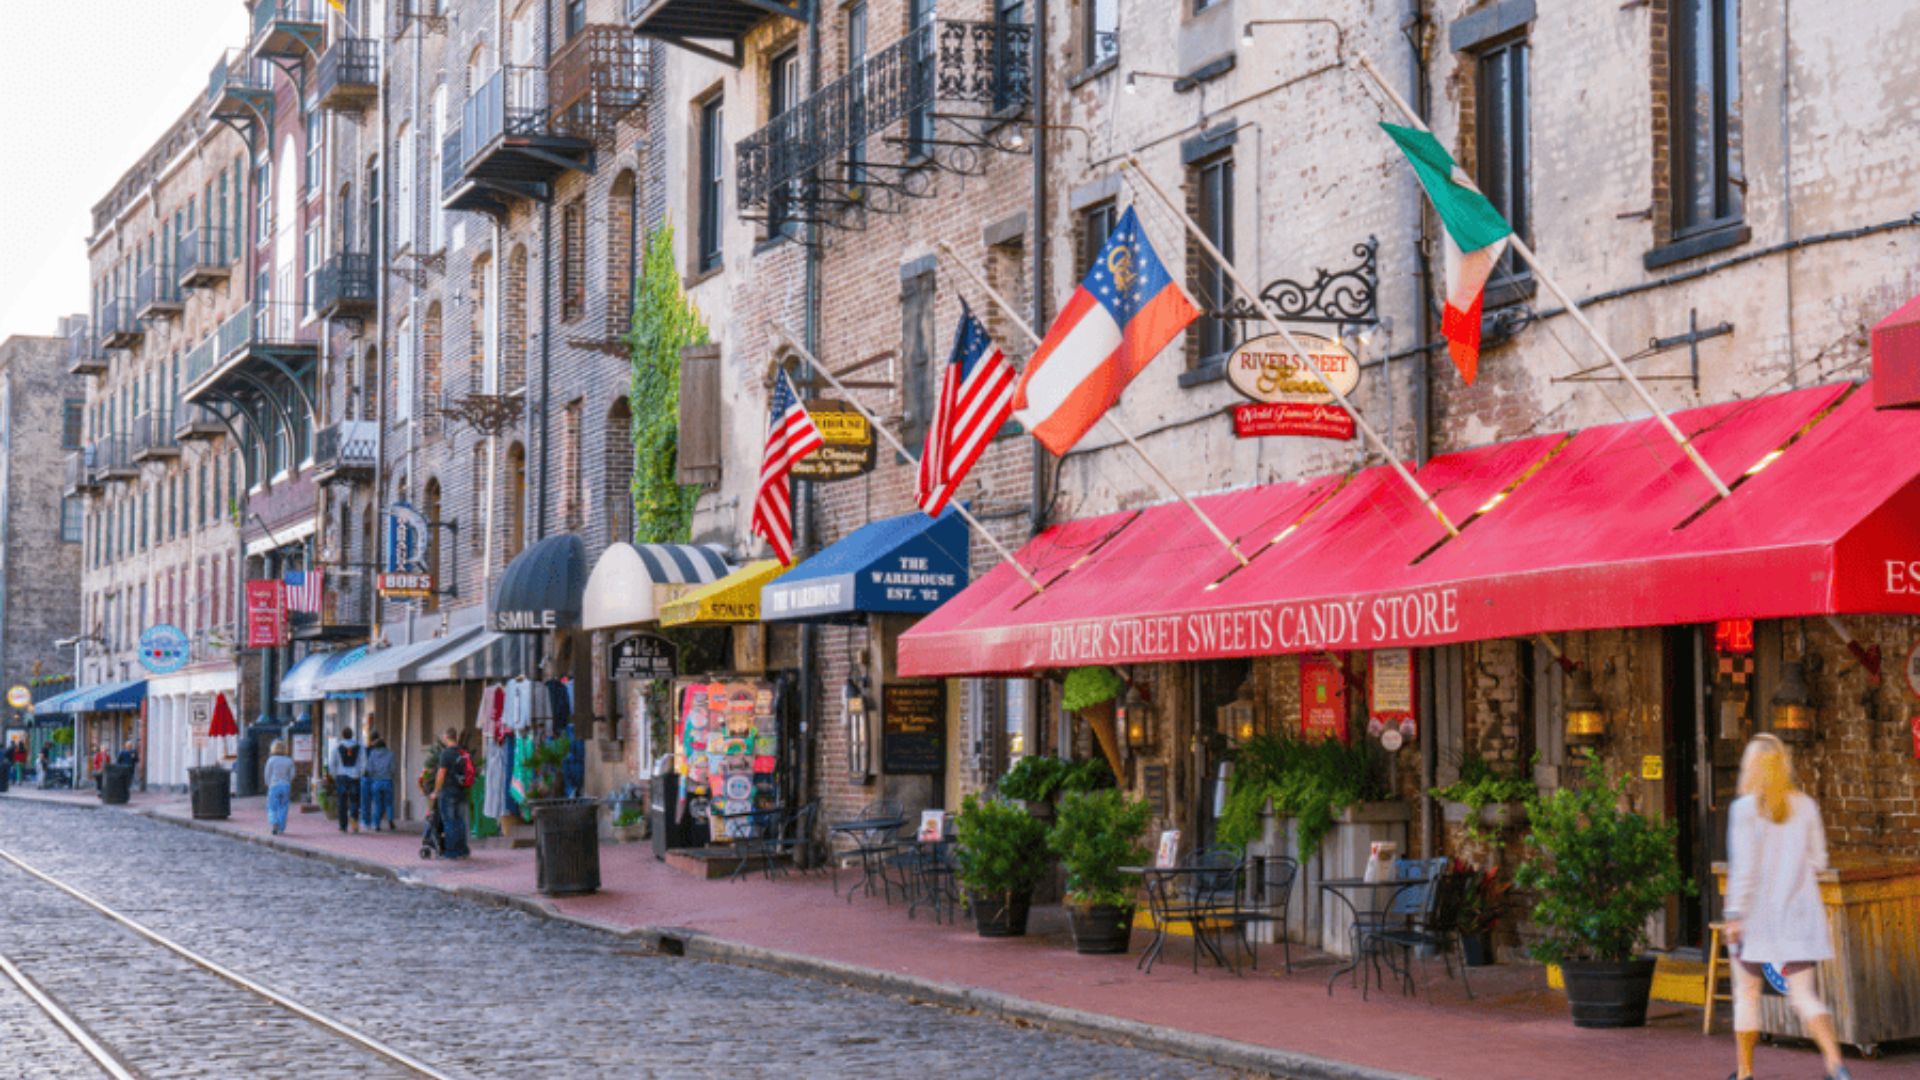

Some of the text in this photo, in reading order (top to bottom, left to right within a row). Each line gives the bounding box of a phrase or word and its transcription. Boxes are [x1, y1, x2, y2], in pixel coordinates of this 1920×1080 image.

[1240, 352, 1349, 372] RIVER SREET
[898, 556, 929, 571] THE
[385, 575, 432, 588] BOB'S
[870, 571, 956, 587] WAREHOUSE
[886, 587, 917, 601] EST.
[498, 609, 557, 630] SMILE
[1050, 588, 1459, 661] RIVER STREET SWEETS CANDY STORE
